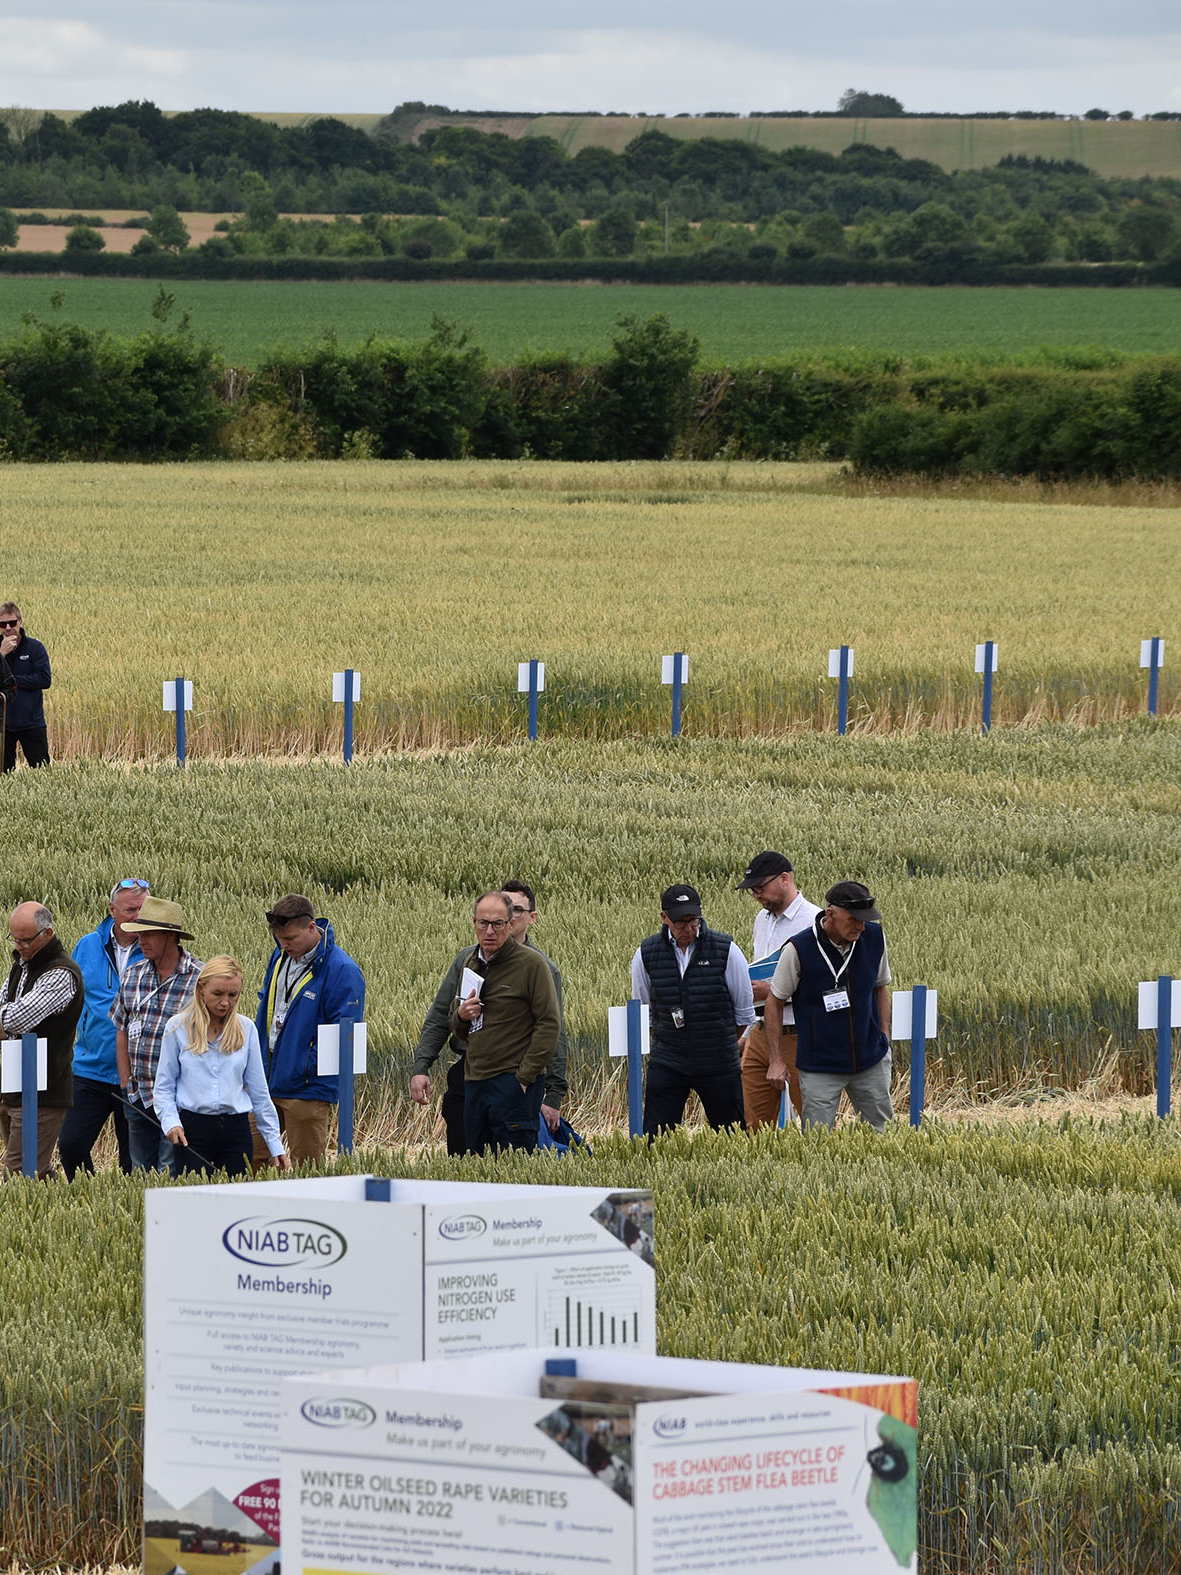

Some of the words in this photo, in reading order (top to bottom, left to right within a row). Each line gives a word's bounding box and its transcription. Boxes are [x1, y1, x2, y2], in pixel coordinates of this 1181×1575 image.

[444, 1221, 465, 1234] NIAB
[466, 1220, 481, 1232] TAG
[492, 1217, 543, 1231] Membership
[237, 1229, 290, 1252] NIAB
[292, 1232, 333, 1255] TAG
[492, 1237, 511, 1248] Make
[512, 1238, 520, 1247] us
[521, 1235, 537, 1247] part
[538, 1234, 546, 1244] of
[547, 1235, 562, 1247] your
[563, 1232, 597, 1246] agronomy
[237, 1274, 332, 1300] Membership
[438, 1273, 498, 1290] IMPROVING
[438, 1290, 493, 1307] NITROGEN
[496, 1288, 516, 1303] USE
[438, 1307, 497, 1324] EFFICIENCY
[309, 1404, 341, 1420] NIAB
[343, 1406, 367, 1421] TAG
[385, 1410, 463, 1431] Membership
[658, 1416, 687, 1431] NIAB
[386, 1433, 414, 1447] Make
[417, 1437, 428, 1447] us
[431, 1436, 453, 1450] part
[456, 1439, 468, 1449] of
[469, 1441, 492, 1454] your
[495, 1445, 546, 1459] agronomy
[653, 1460, 677, 1478] THE
[680, 1453, 753, 1477] CHANGING
[756, 1447, 822, 1470] LIFECYCLE
[826, 1445, 845, 1462] OF
[260, 1482, 274, 1495] Sign
[300, 1469, 365, 1490] WINTER
[369, 1475, 437, 1496] OILSEED
[442, 1481, 483, 1501] RAPE
[488, 1485, 568, 1508] VARIETIES
[652, 1477, 713, 1500] CABBAGE
[718, 1474, 752, 1494] STEM
[756, 1470, 787, 1489] FLEA
[791, 1466, 838, 1487] BEETLE
[239, 1495, 262, 1508] FREE
[263, 1497, 276, 1509] 90
[300, 1489, 334, 1508] FOR
[338, 1493, 410, 1514] AUTUMN
[416, 1500, 454, 1519] 2022
[263, 1511, 274, 1521] the
